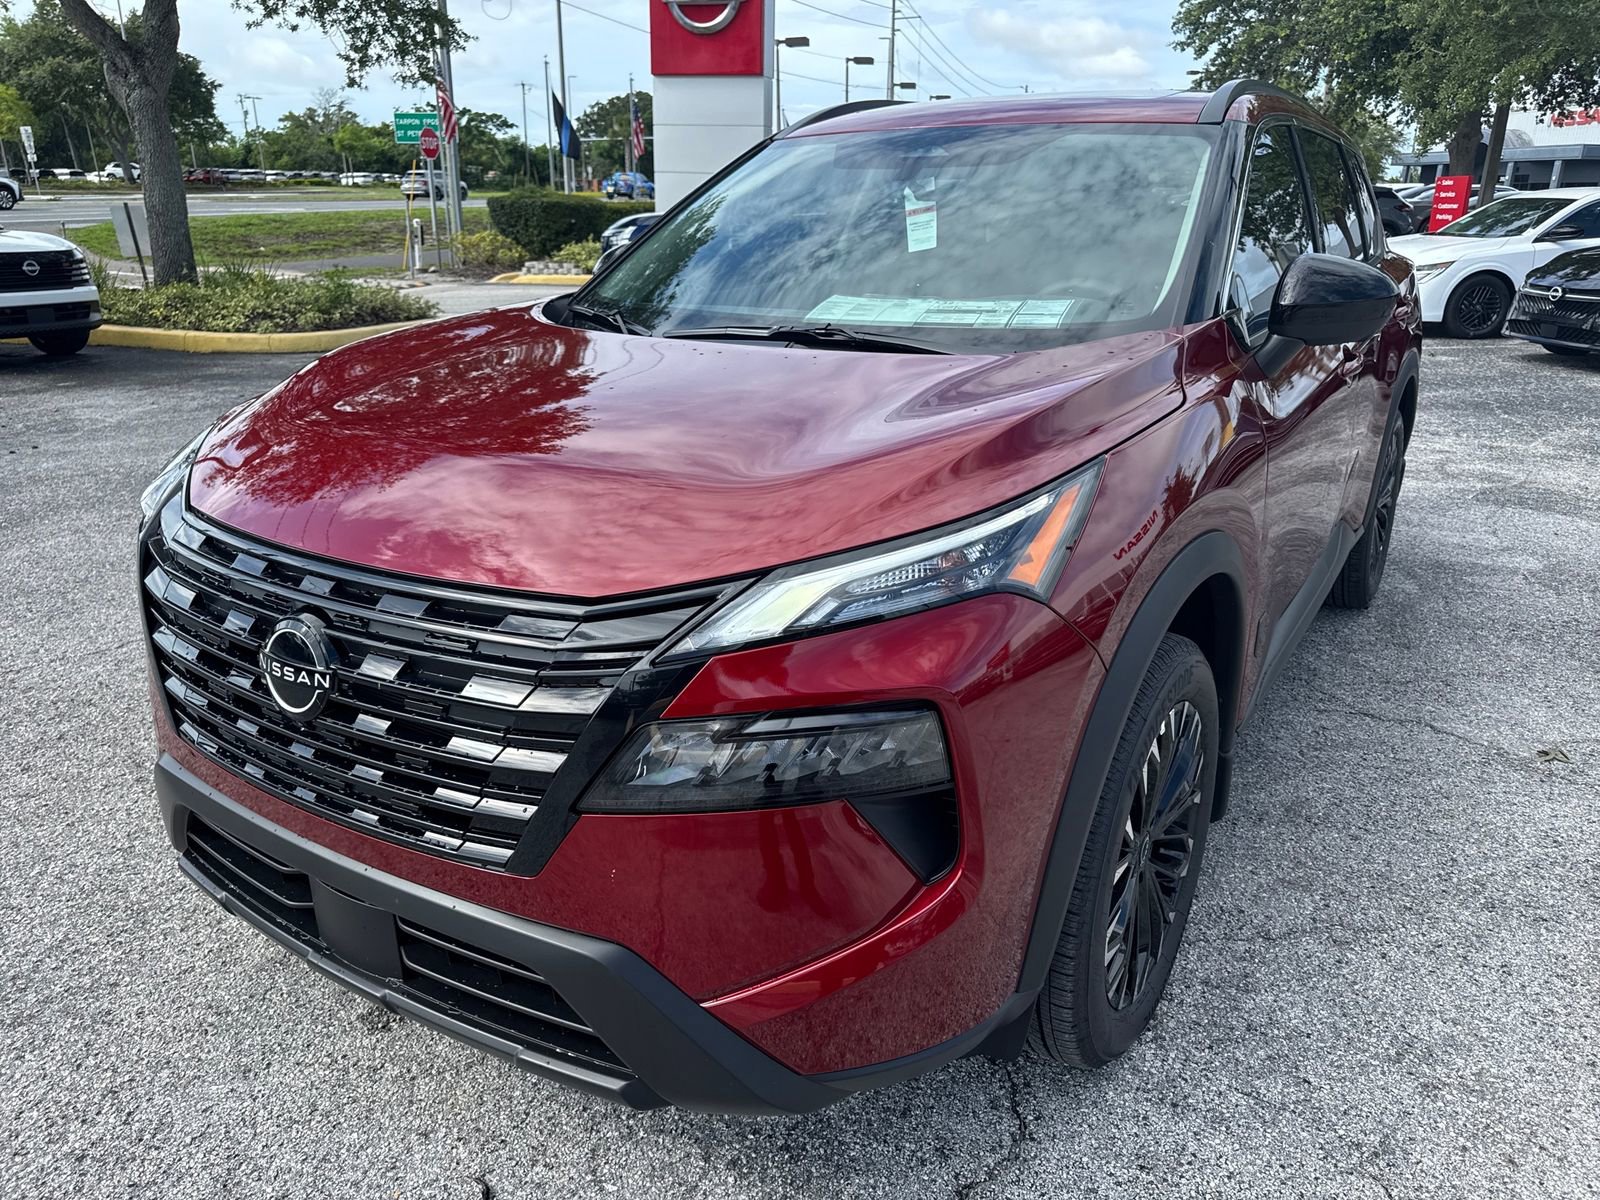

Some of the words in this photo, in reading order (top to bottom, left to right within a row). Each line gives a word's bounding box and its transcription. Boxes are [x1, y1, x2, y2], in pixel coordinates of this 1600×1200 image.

[421, 137, 438, 149] STOP
[1435, 213, 1453, 221] Parking
[260, 652, 330, 688] NISSAN
